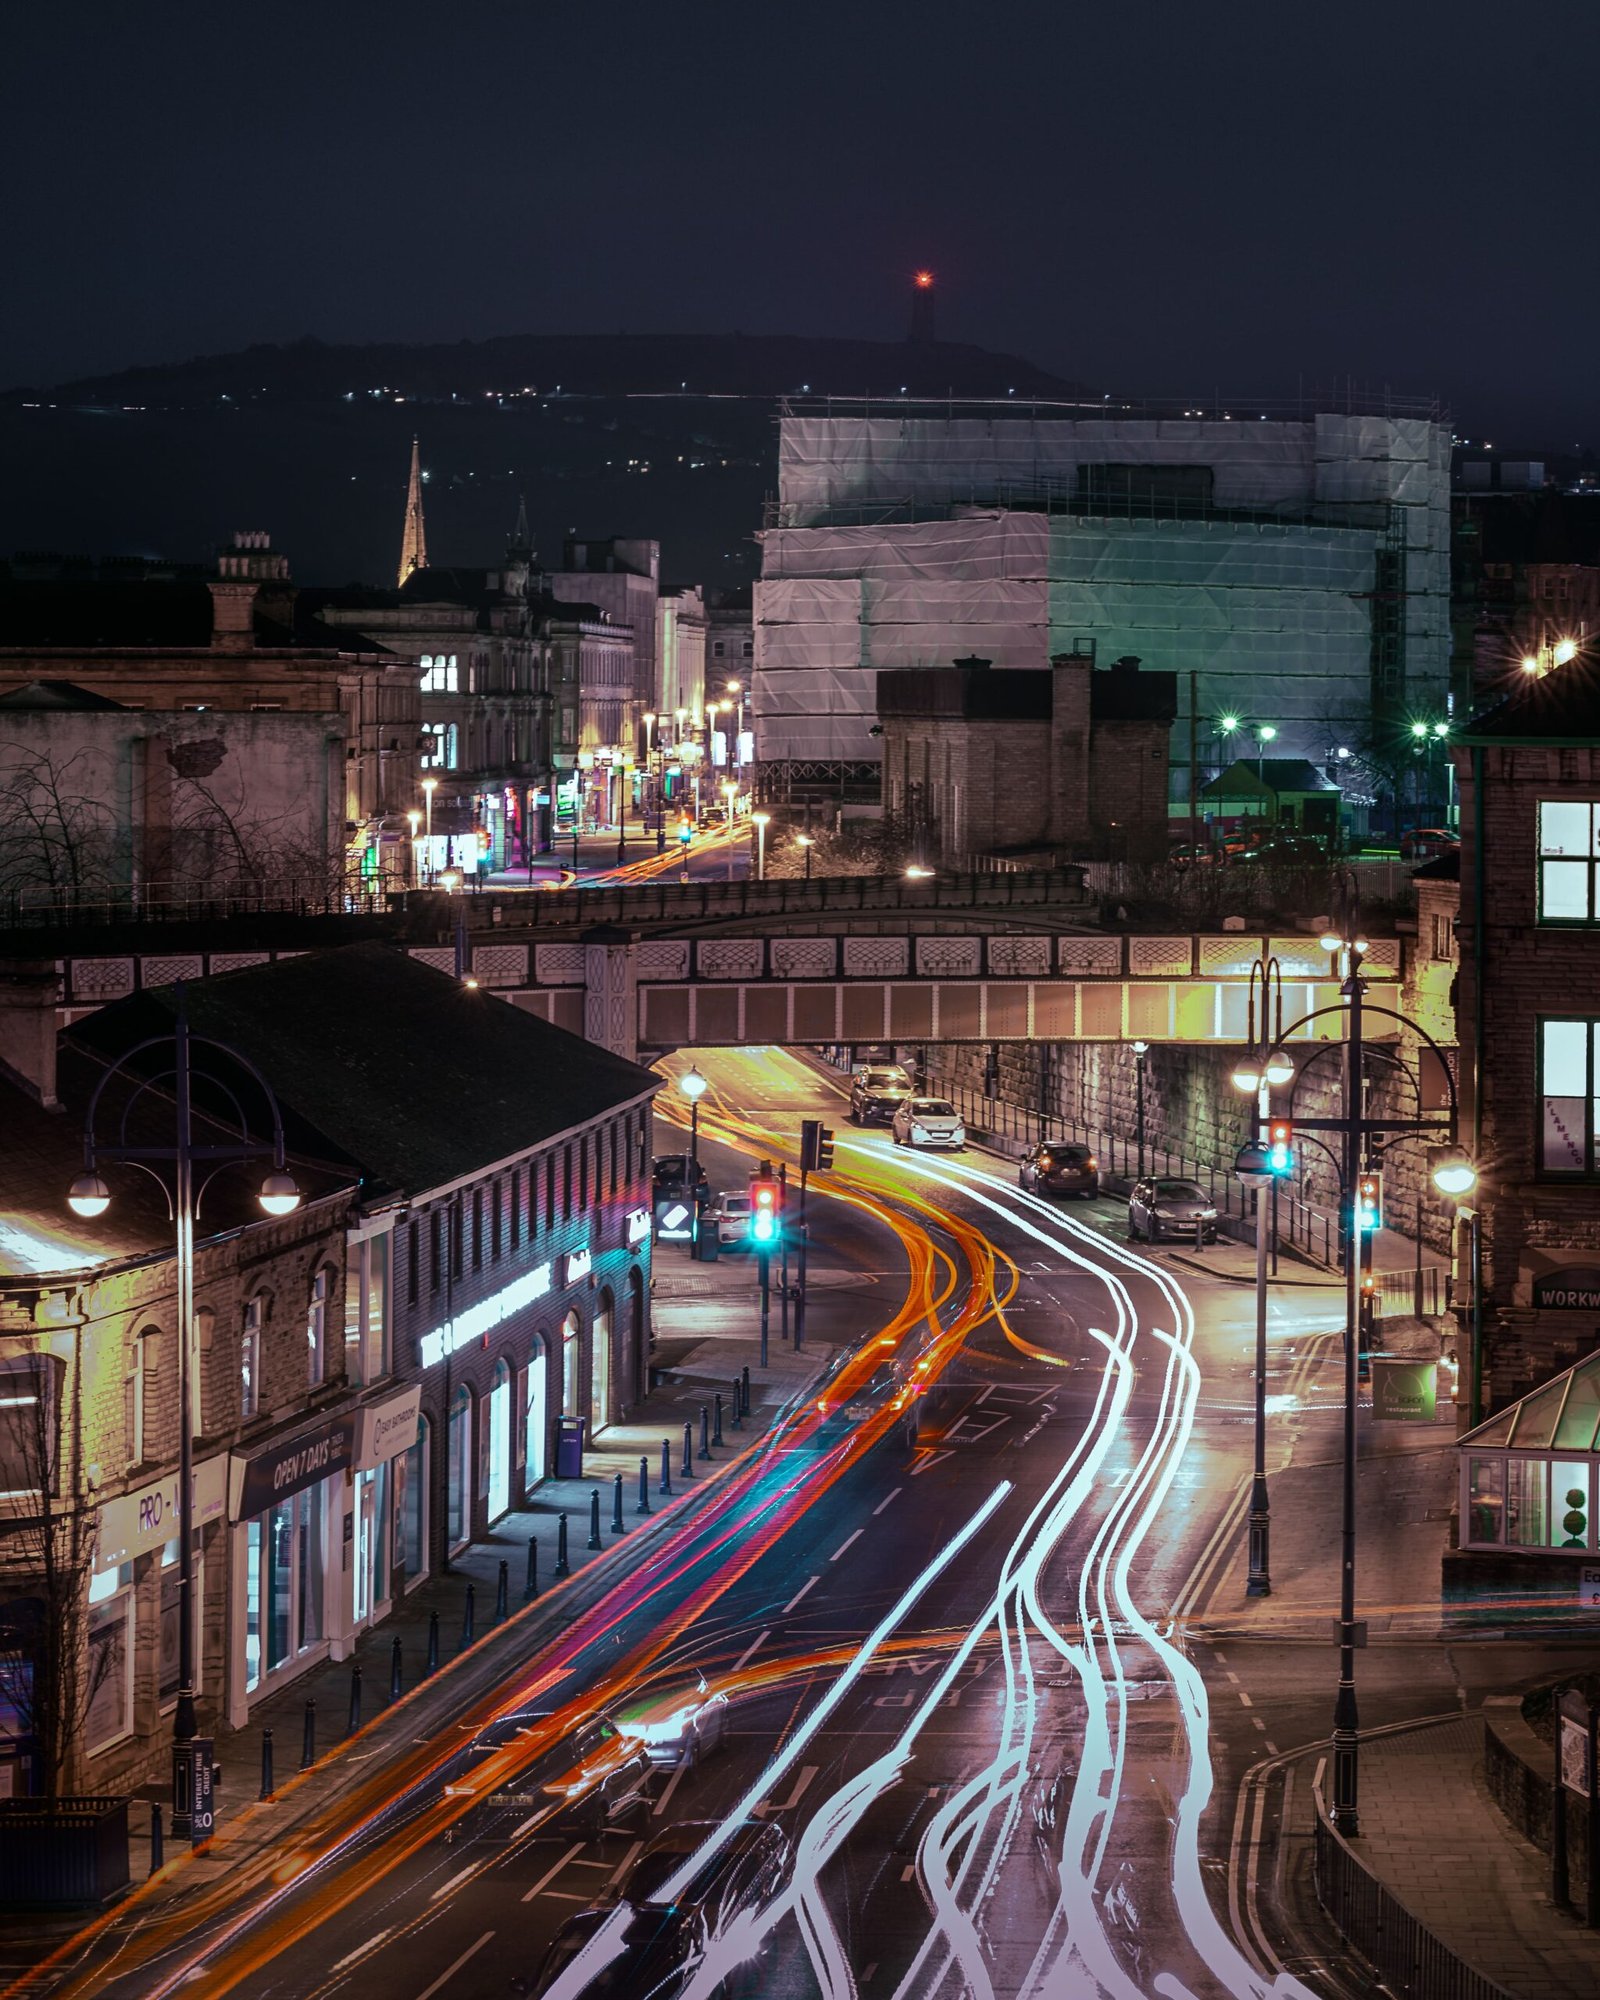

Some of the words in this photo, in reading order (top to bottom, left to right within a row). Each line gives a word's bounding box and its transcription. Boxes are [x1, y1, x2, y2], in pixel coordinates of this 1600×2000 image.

[1547, 1101, 1583, 1165] FLAMENCO
[1542, 1290, 1600, 1307] WORKW
[274, 1452, 299, 1490] OPEN
[299, 1450, 306, 1476] 7
[307, 1438, 330, 1473] DAYS
[138, 1492, 162, 1534] PRO
[195, 1752, 203, 1771] FREE
[195, 1772, 203, 1810] INTEREST
